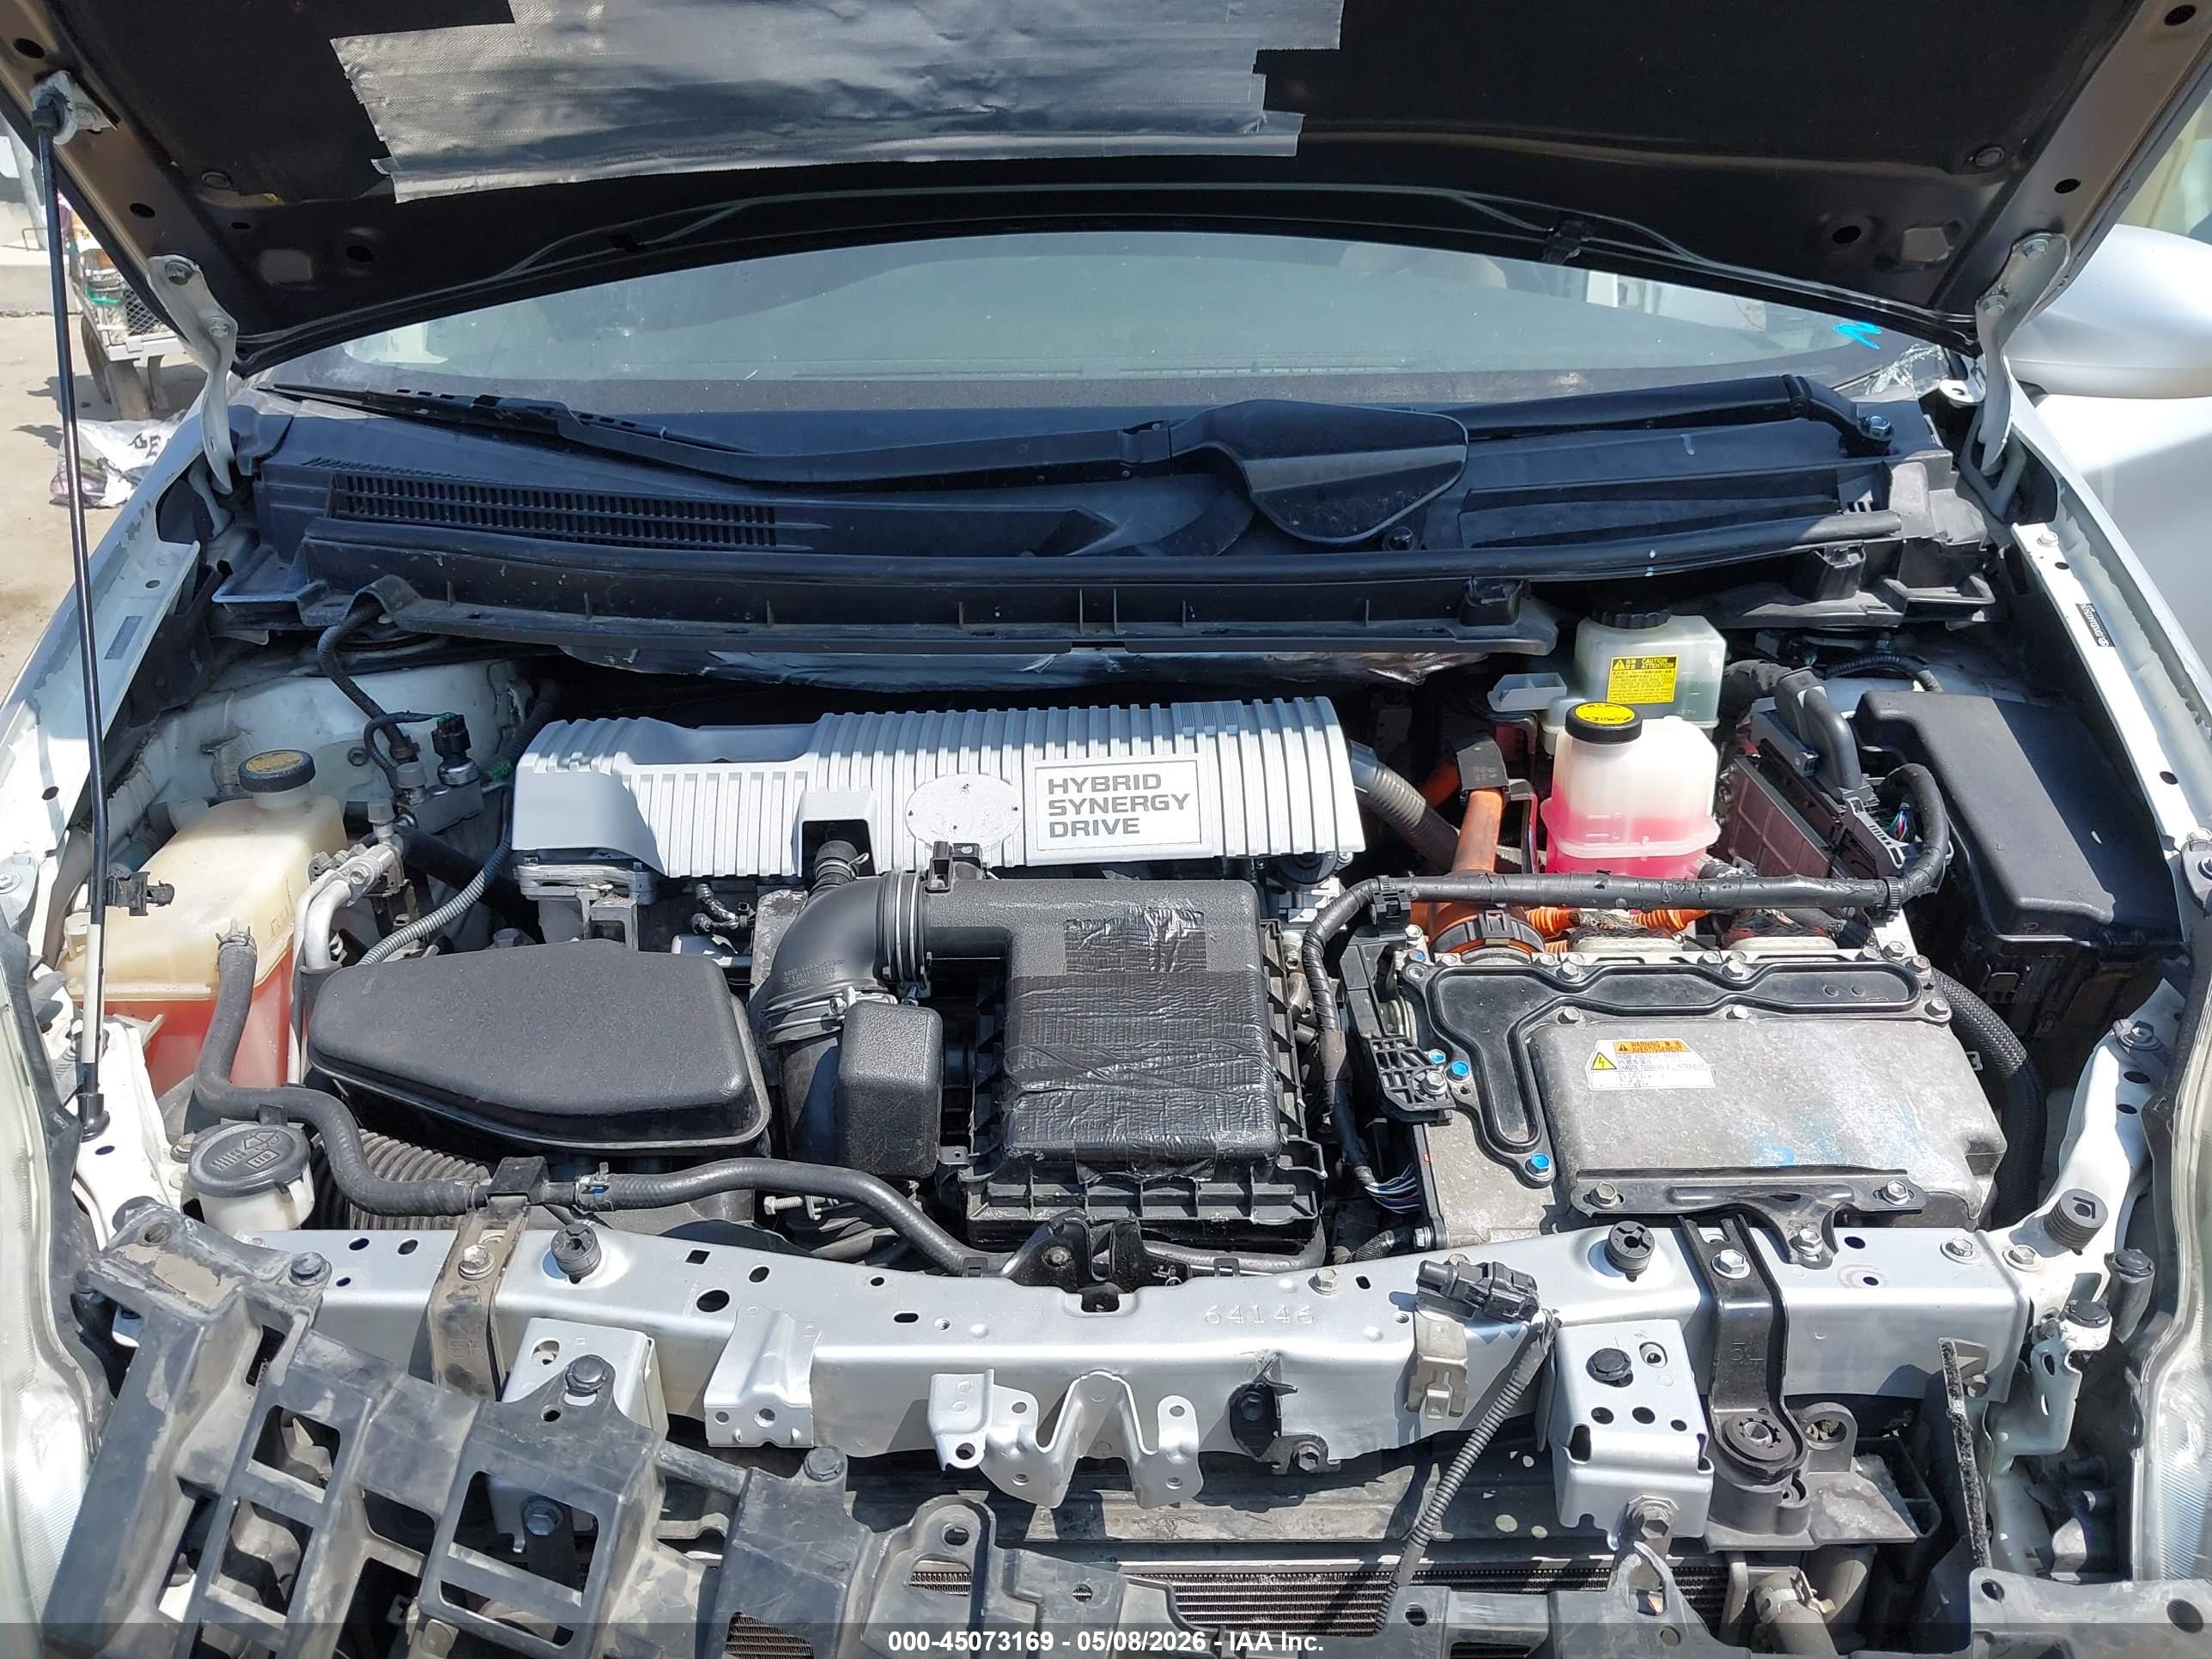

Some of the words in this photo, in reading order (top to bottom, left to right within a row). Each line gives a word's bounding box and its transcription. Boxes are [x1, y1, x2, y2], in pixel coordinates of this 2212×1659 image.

[1048, 774, 1162, 795] HYBRID
[1048, 793, 1190, 816] SYNERGY
[1049, 817, 1140, 838] DRIVE
[1205, 1304, 1315, 1325] 64146
